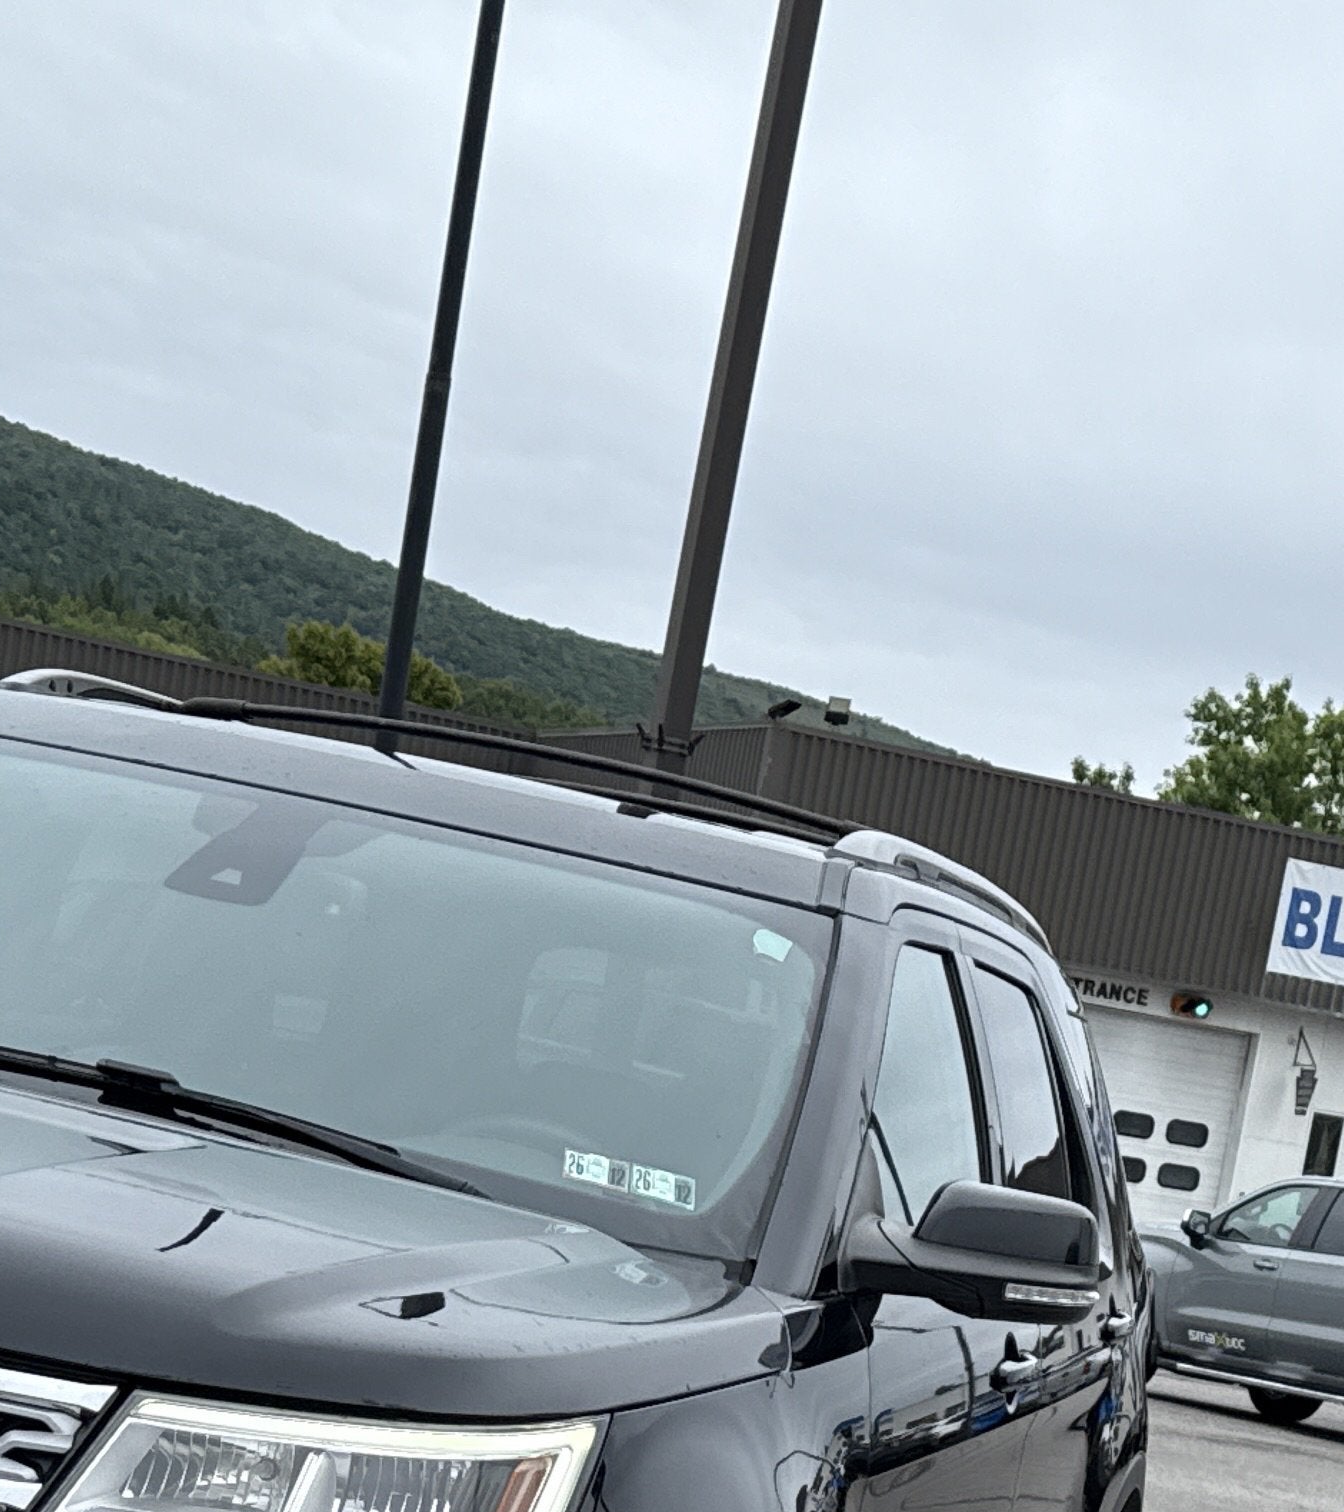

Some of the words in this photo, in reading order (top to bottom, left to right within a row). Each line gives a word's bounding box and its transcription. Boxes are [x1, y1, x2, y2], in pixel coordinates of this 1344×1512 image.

[1070, 976, 1150, 1007] TRANCE
[567, 1152, 586, 1176] 26
[609, 1166, 626, 1187] 12
[634, 1168, 652, 1192] 26
